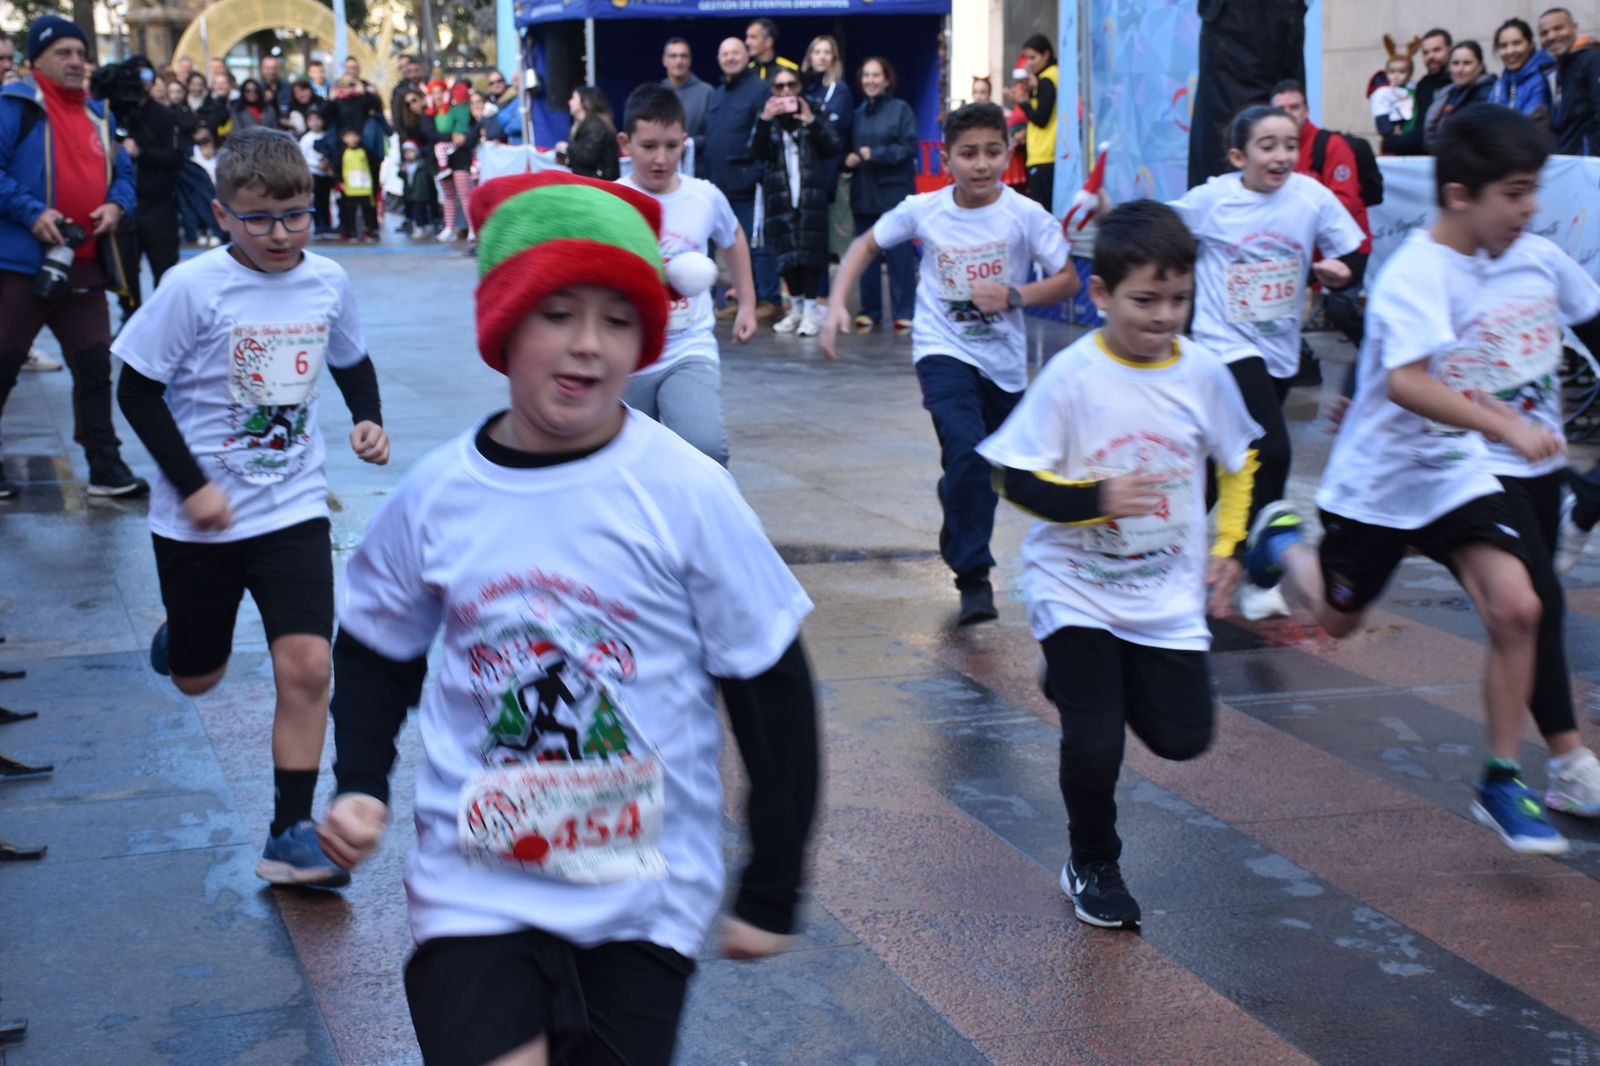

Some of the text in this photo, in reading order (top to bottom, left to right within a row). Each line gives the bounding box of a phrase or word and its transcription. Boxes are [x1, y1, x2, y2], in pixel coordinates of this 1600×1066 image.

[965, 259, 1002, 281] 506
[1259, 280, 1296, 302] 216
[295, 351, 309, 375] 6
[552, 799, 643, 849] 454
